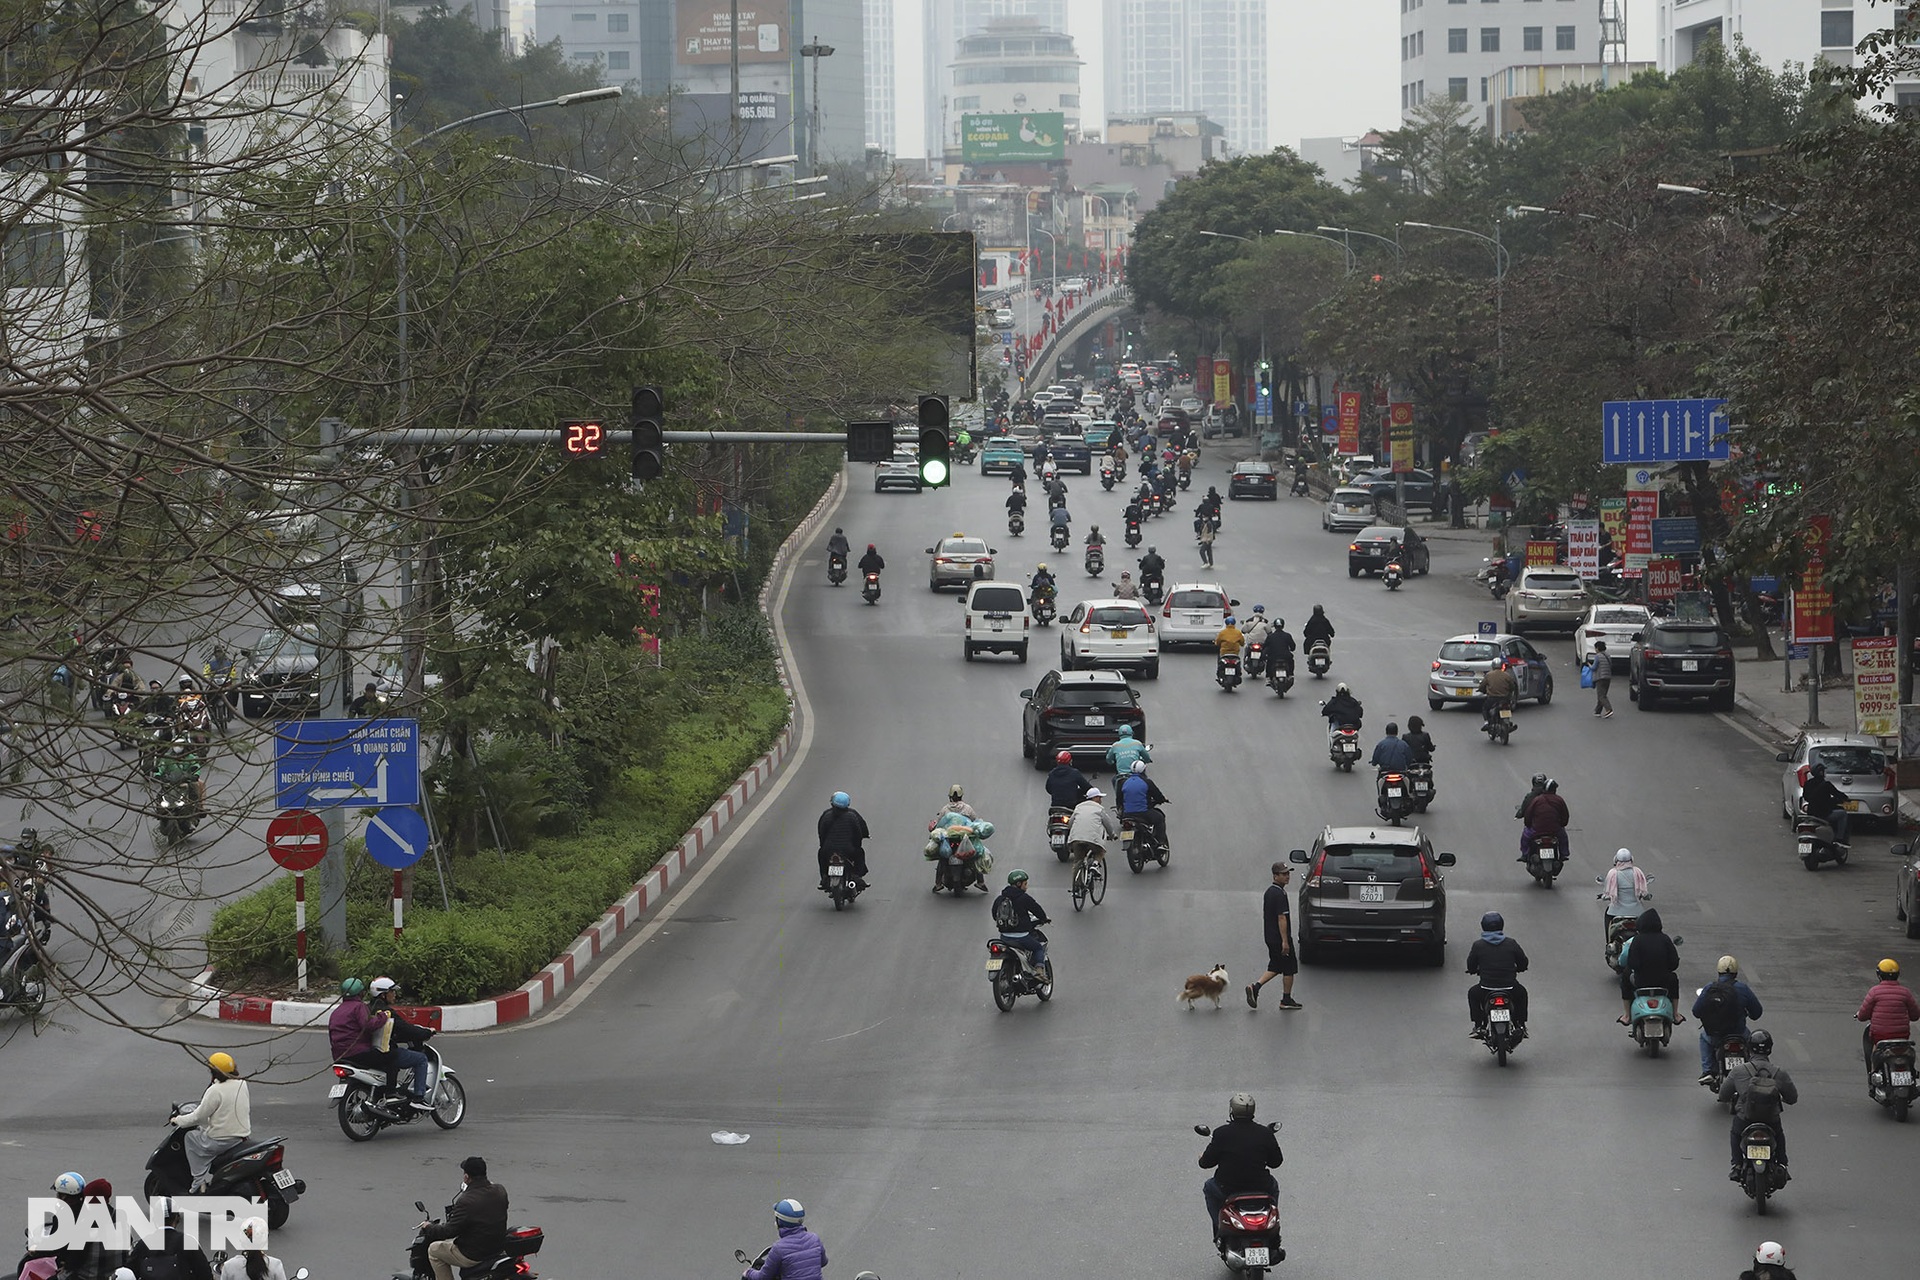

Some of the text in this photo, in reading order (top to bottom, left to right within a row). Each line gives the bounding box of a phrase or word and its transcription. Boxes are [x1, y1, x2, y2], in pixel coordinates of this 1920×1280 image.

[742, 12, 756, 20] TAY
[967, 132, 1009, 141] ECOPARK
[1299, 403, 1305, 411] P
[567, 425, 600, 451] 22
[1570, 531, 1583, 543] TRÁI
[1649, 565, 1666, 584] PHỞ
[1669, 566, 1680, 584] BÒ
[1650, 586, 1662, 596] CƠM
[1875, 692, 1890, 701] Vàng
[1860, 701, 1882, 713] 9999
[353, 743, 361, 755] TẠ
[364, 742, 389, 754] QUANG
[332, 767, 355, 782] CHIỂU
